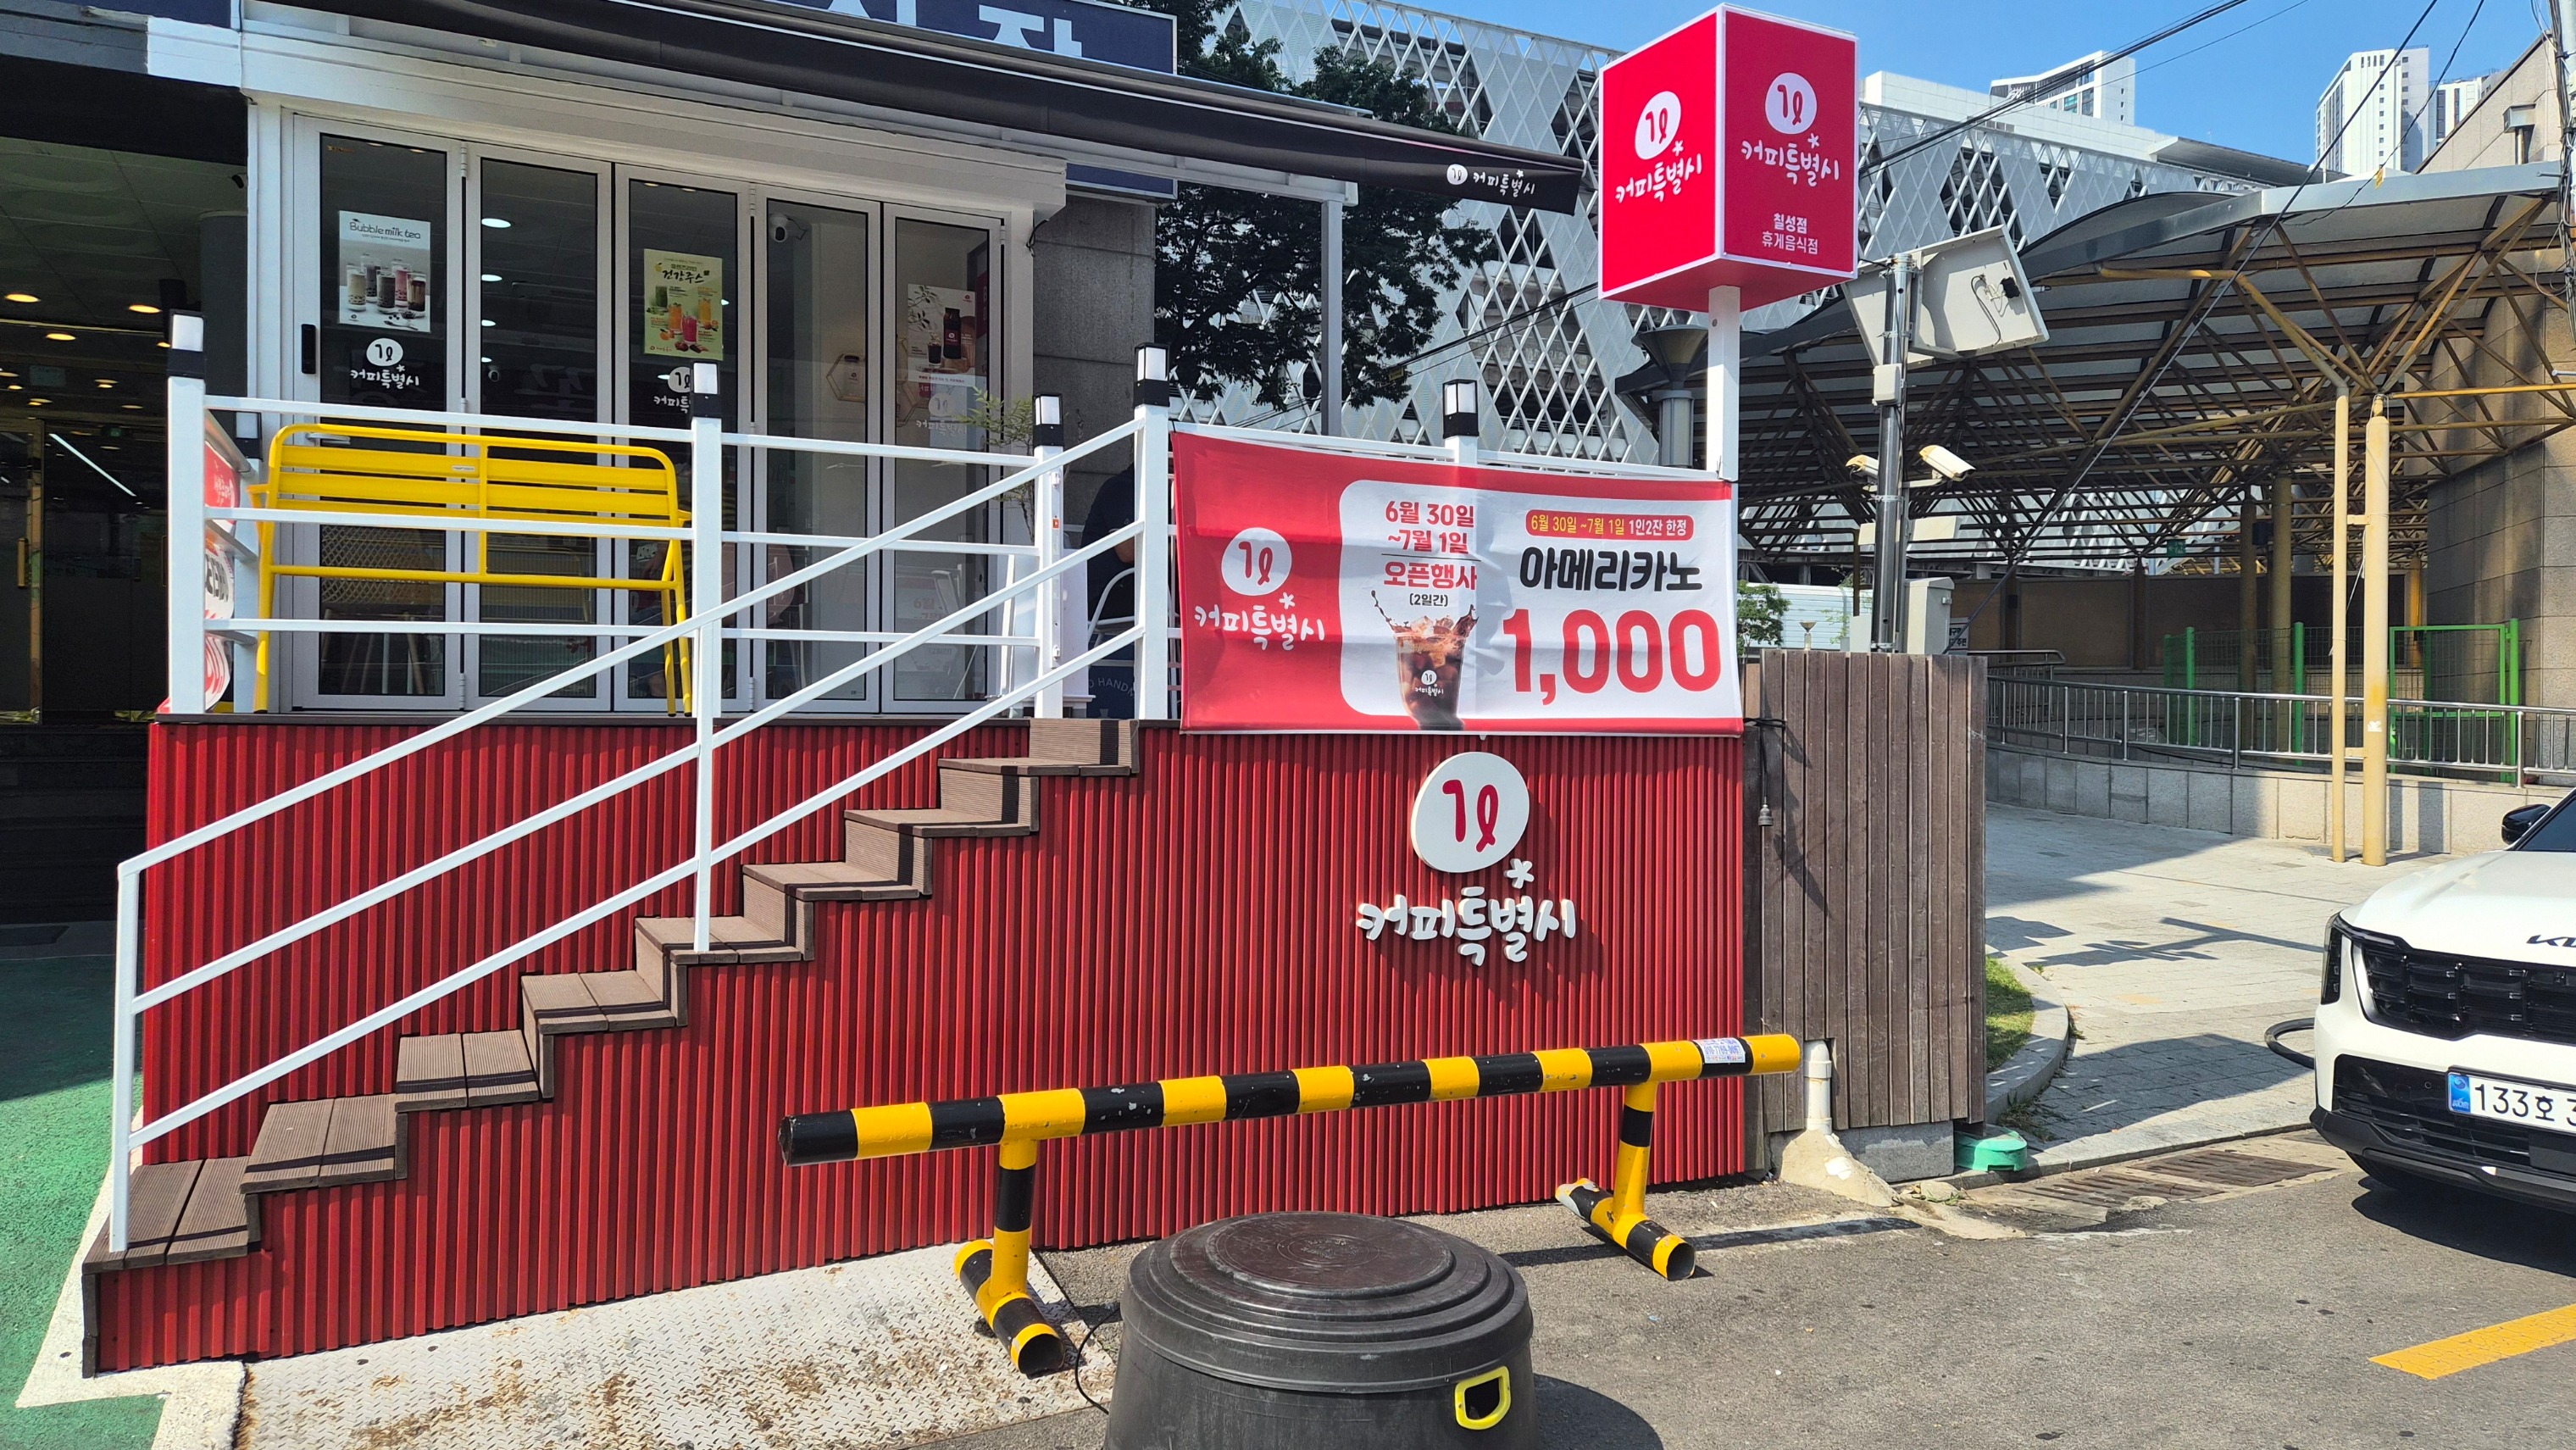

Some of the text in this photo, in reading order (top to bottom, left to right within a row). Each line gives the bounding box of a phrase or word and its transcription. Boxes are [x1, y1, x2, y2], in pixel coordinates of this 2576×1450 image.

[1741, 139, 1840, 187] 커피특별시
[1473, 171, 1535, 197] 커피특별시
[1615, 153, 1702, 203] 커피특별시
[349, 221, 384, 235] Bubble
[385, 227, 403, 237] milk
[404, 229, 421, 240] tea
[1773, 213, 1807, 235] 칠성점
[1762, 231, 1818, 255] 휴게음식점
[662, 269, 705, 284] 건강주스
[350, 369, 419, 389] 커피특별시
[653, 395, 691, 414] 커피특
[1385, 501, 1474, 528] 6월 30일
[1531, 514, 1549, 532] 6월
[1552, 516, 1577, 533] 30일
[1608, 519, 1625, 536] 1일
[1629, 519, 1663, 536] 1인2잔
[1666, 519, 1687, 536] 한정
[1388, 529, 1468, 554] ~7월 1일
[1384, 561, 1478, 591] 오픈행사
[1519, 547, 1703, 592] 아메리카노
[1409, 593, 1448, 607] (2일간)
[1194, 604, 1325, 651] 커피특별시
[1502, 608, 1722, 706] 1,000
[1356, 886, 1576, 966] 커피특별시
[2474, 1083, 2556, 1122] 133호
